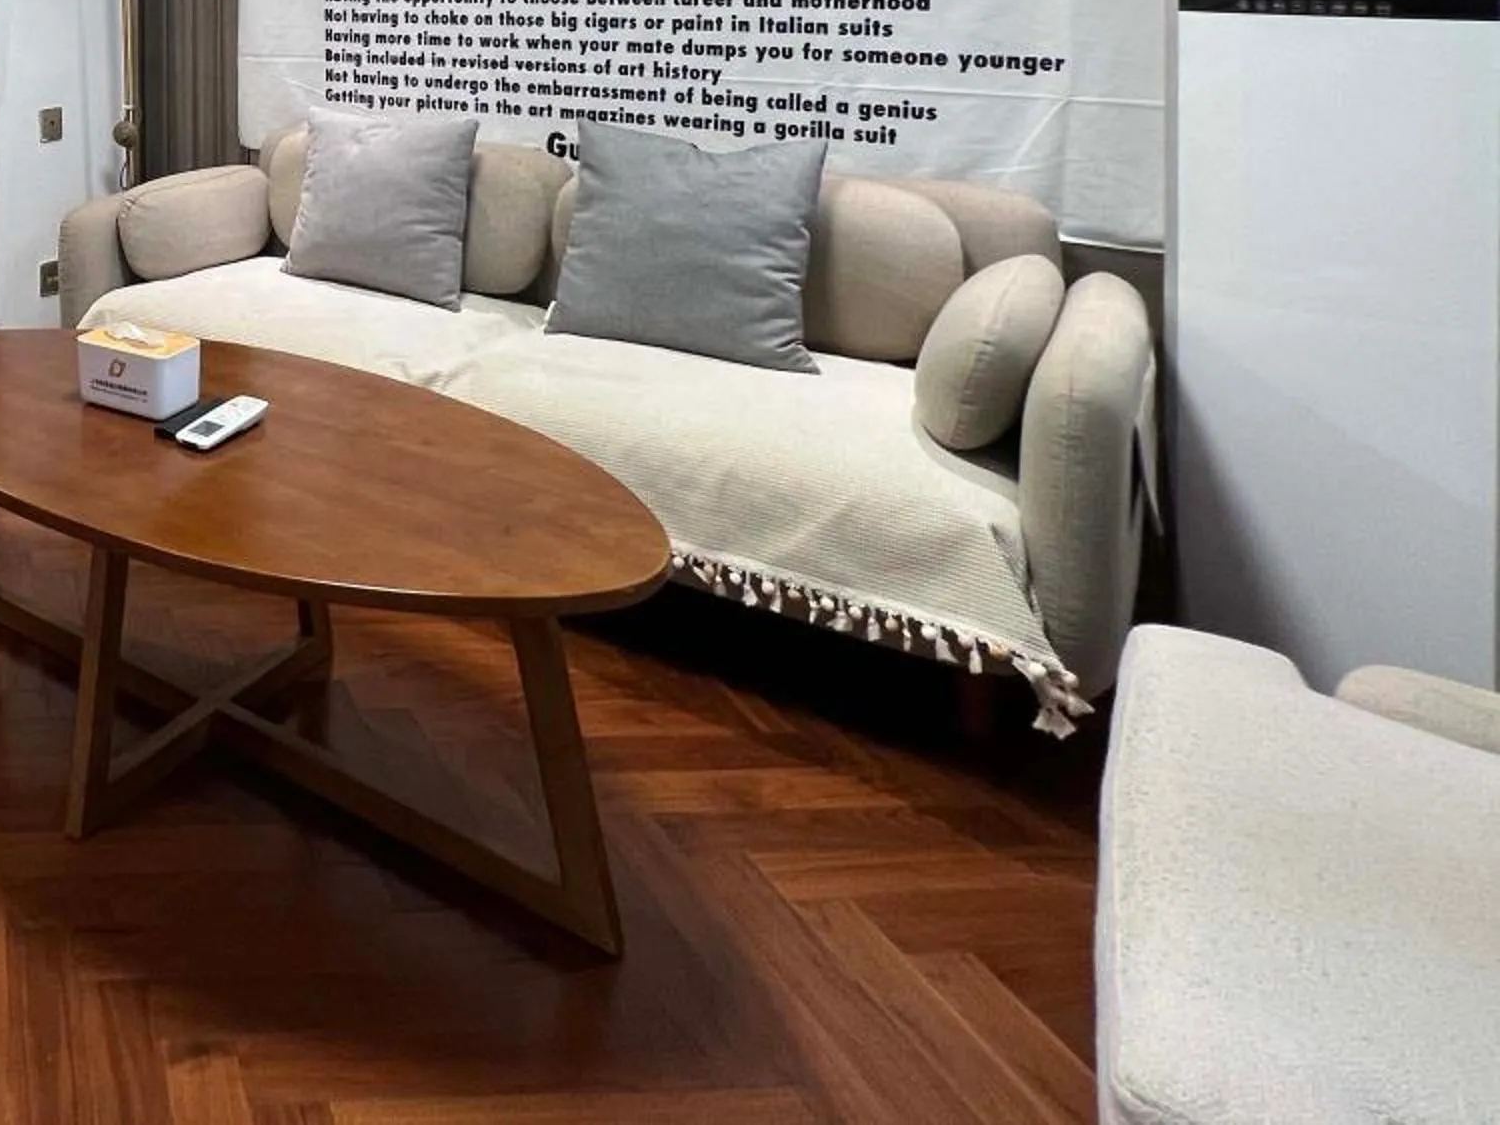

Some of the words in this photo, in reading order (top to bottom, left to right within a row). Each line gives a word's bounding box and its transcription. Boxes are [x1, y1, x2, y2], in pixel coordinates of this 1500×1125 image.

[324, 8, 348, 22] Not
[351, 8, 399, 28] having
[403, 11, 419, 24] to
[424, 9, 469, 25] choke
[474, 14, 493, 25] on
[498, 11, 545, 27] those
[550, 11, 578, 32] big
[584, 12, 637, 33] cigars
[643, 18, 665, 30] or
[671, 14, 724, 35] paint
[730, 15, 751, 33] in
[759, 16, 829, 35] Italian
[838, 17, 894, 37] suits
[324, 48, 362, 67] Being
[366, 50, 426, 66] included
[431, 52, 446, 67] in
[451, 54, 510, 70] revised
[514, 57, 587, 74] versions
[593, 59, 612, 75] of
[617, 63, 646, 77] art
[652, 61, 722, 86] history
[325, 28, 370, 47] Having
[375, 34, 412, 45] more
[417, 31, 452, 46] time
[457, 33, 474, 47] to
[478, 33, 520, 49] work
[525, 34, 573, 51] when
[578, 40, 620, 55] your
[626, 39, 675, 54] mate
[681, 38, 748, 62] dumps
[755, 46, 794, 63] you
[802, 42, 834, 61] for
[842, 49, 949, 66] someone
[958, 54, 1066, 76] younger
[325, 68, 348, 83] Not
[352, 69, 399, 90] having
[404, 74, 419, 87] to
[424, 74, 489, 95] undergo
[494, 77, 521, 93] the
[526, 79, 667, 102] embarrassment
[673, 87, 694, 104] of
[701, 87, 758, 113] being
[766, 93, 828, 113] called
[835, 102, 850, 115] a
[858, 100, 938, 121] genius
[325, 88, 374, 109] Getting
[378, 96, 411, 109] your
[416, 94, 469, 113] picture
[474, 97, 490, 113] in
[495, 99, 522, 115] the
[528, 104, 553, 118] art
[663, 113, 745, 137] wearing
[753, 121, 766, 134] a
[774, 120, 845, 141] gorilla
[853, 125, 897, 145] suit
